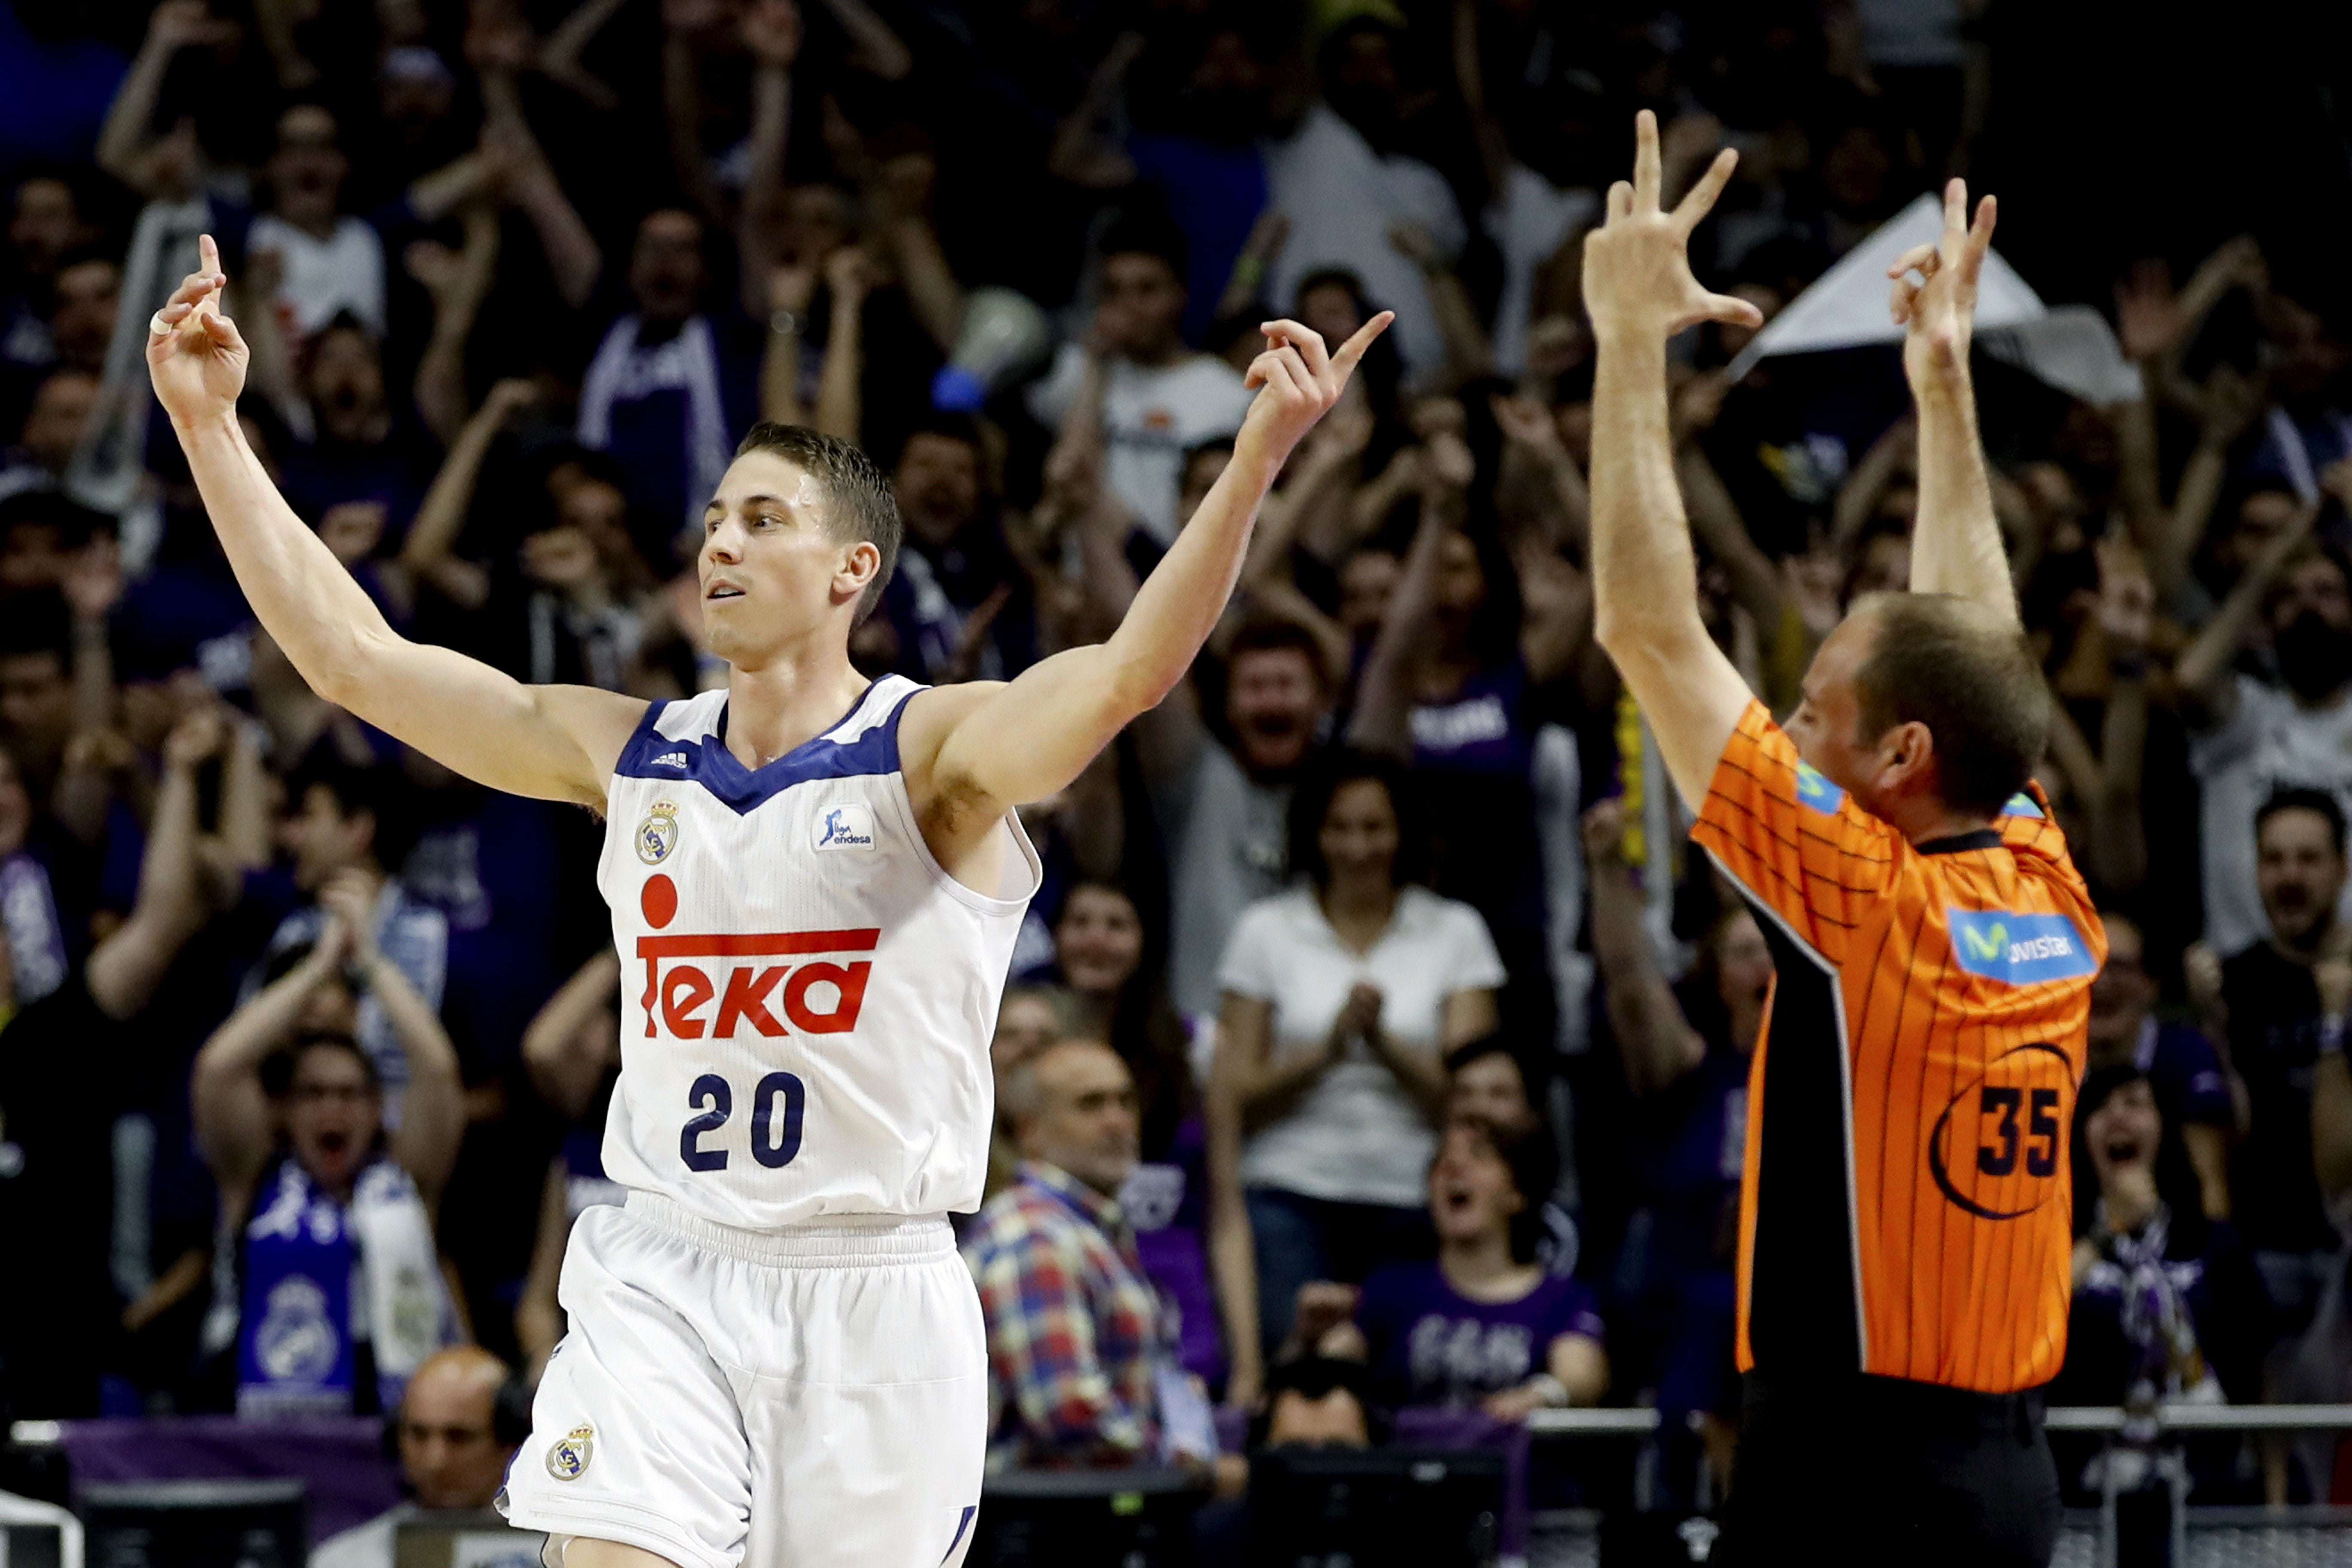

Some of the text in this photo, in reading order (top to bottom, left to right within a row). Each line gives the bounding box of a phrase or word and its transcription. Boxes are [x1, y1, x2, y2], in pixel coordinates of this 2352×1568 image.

[834, 834, 870, 844] endesa
[680, 1072, 805, 1172] 20
[1978, 1088, 2060, 1176] 35
